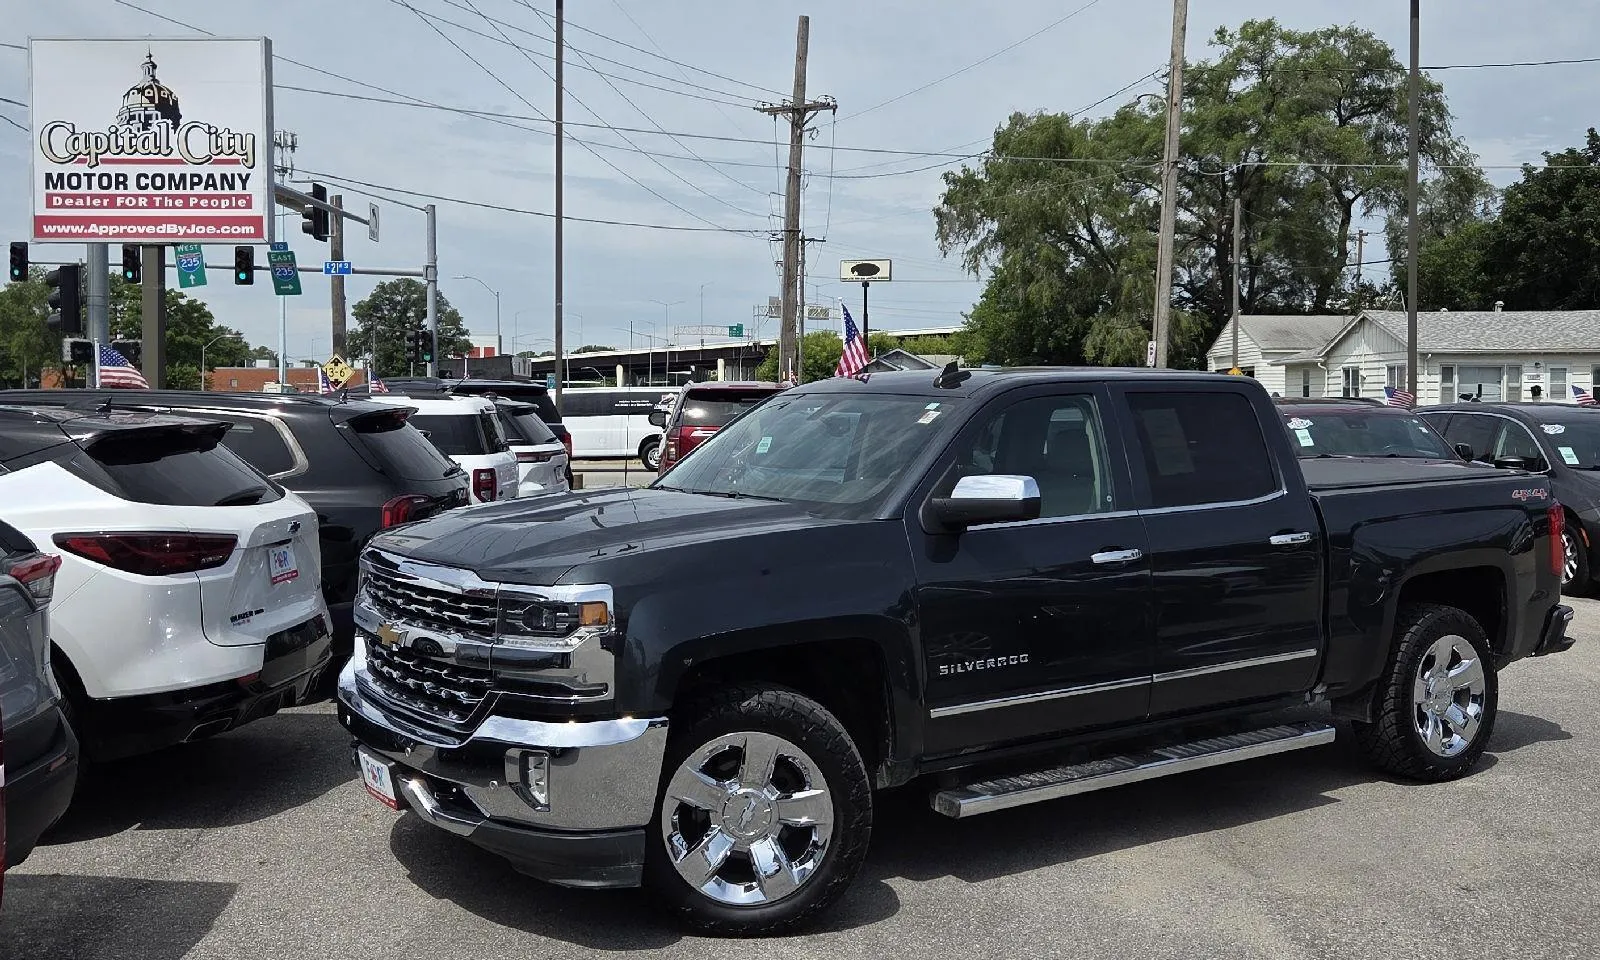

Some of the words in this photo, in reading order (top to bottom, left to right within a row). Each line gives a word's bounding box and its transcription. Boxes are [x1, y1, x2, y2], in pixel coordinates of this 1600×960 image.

[40, 121, 173, 168] Capital
[177, 121, 255, 169] City
[45, 172, 128, 190] MOTOR
[136, 172, 251, 190] COMPANY
[52, 196, 110, 207] Dealer
[116, 196, 148, 207] FOR
[153, 196, 184, 207] The
[190, 197, 247, 209] People
[43, 223, 255, 236] www.ApprovedByJoe.com
[177, 244, 198, 252] WEST
[181, 259, 200, 268] 235
[271, 254, 292, 262] EAST
[275, 268, 294, 276] 235
[939, 654, 1029, 676] SILVERADO
